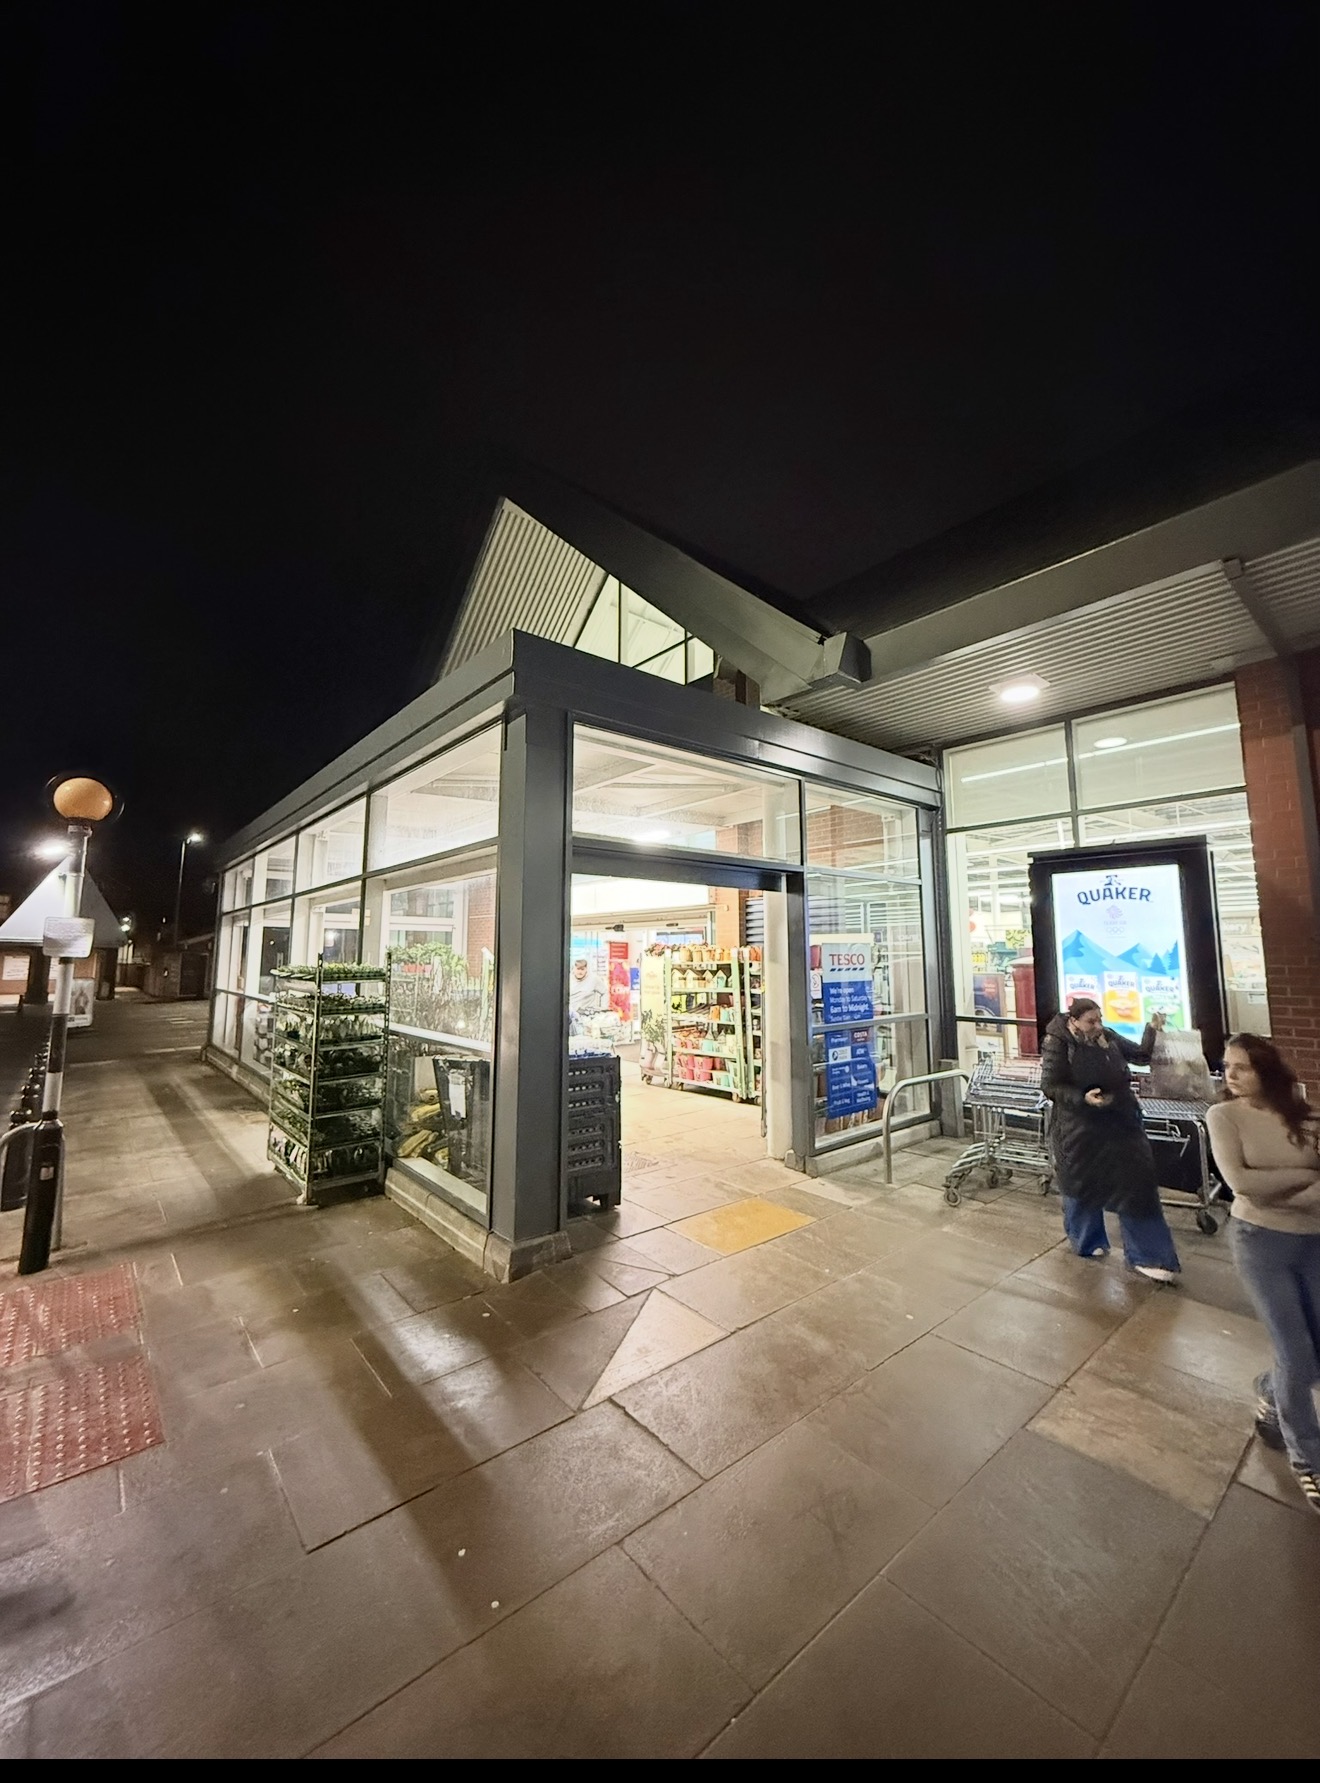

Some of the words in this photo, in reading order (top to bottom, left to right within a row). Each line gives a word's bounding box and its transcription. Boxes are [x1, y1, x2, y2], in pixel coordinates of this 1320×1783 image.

[1077, 887, 1152, 905] QUAKER
[829, 953, 865, 966] TESCO
[842, 1004, 848, 1012] to
